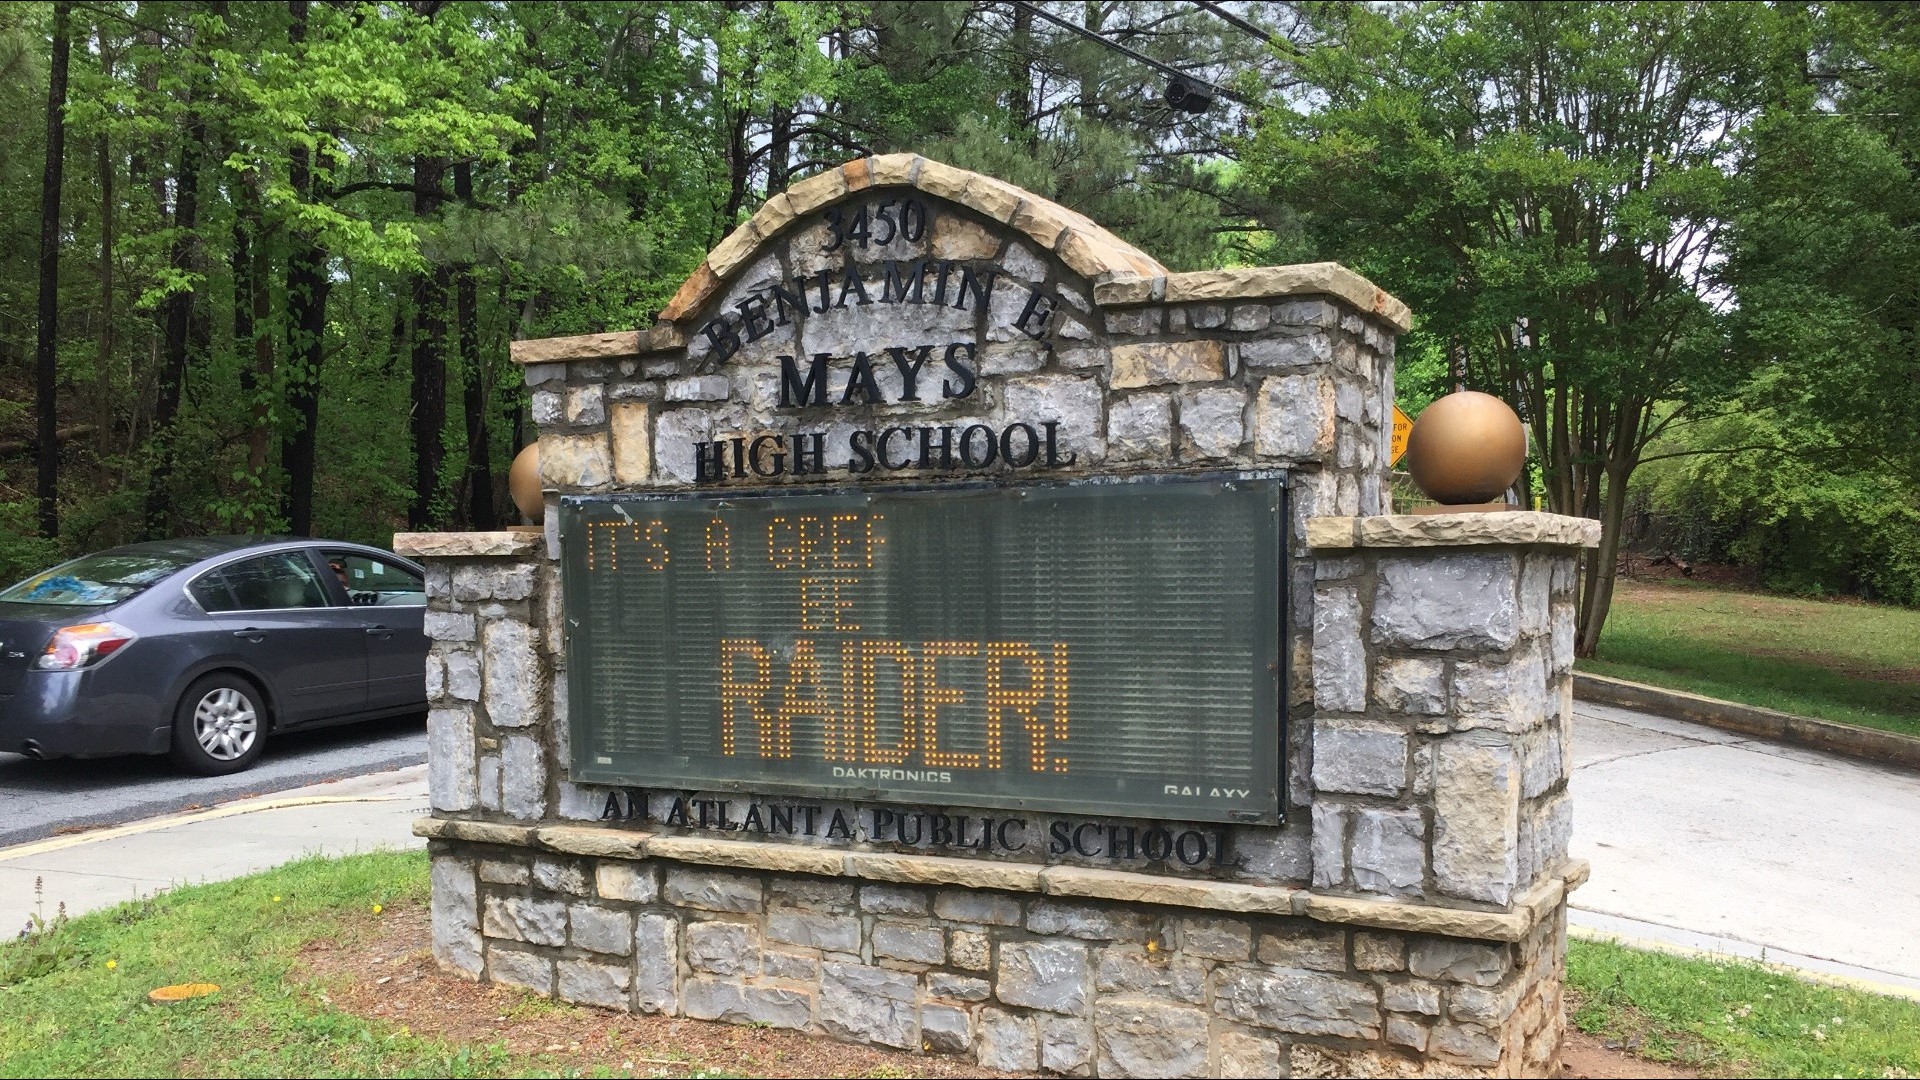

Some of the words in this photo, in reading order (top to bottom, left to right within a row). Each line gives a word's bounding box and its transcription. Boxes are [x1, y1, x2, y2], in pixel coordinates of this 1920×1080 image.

[821, 199, 926, 252] 3450
[700, 260, 998, 365] BENJAMIN
[776, 342, 976, 408] MAYS
[693, 431, 828, 482] HIGH
[849, 421, 1077, 475] SCHOOL
[588, 520, 669, 570] IT'S
[705, 518, 731, 570] A
[720, 638, 1069, 773] RAIDER!
[832, 766, 951, 784] DAKTRONICS
[600, 788, 650, 821] AN
[665, 796, 856, 839] ATLANTA
[870, 807, 1026, 852] PUBLIC
[1050, 820, 1244, 867] SCHOOL
